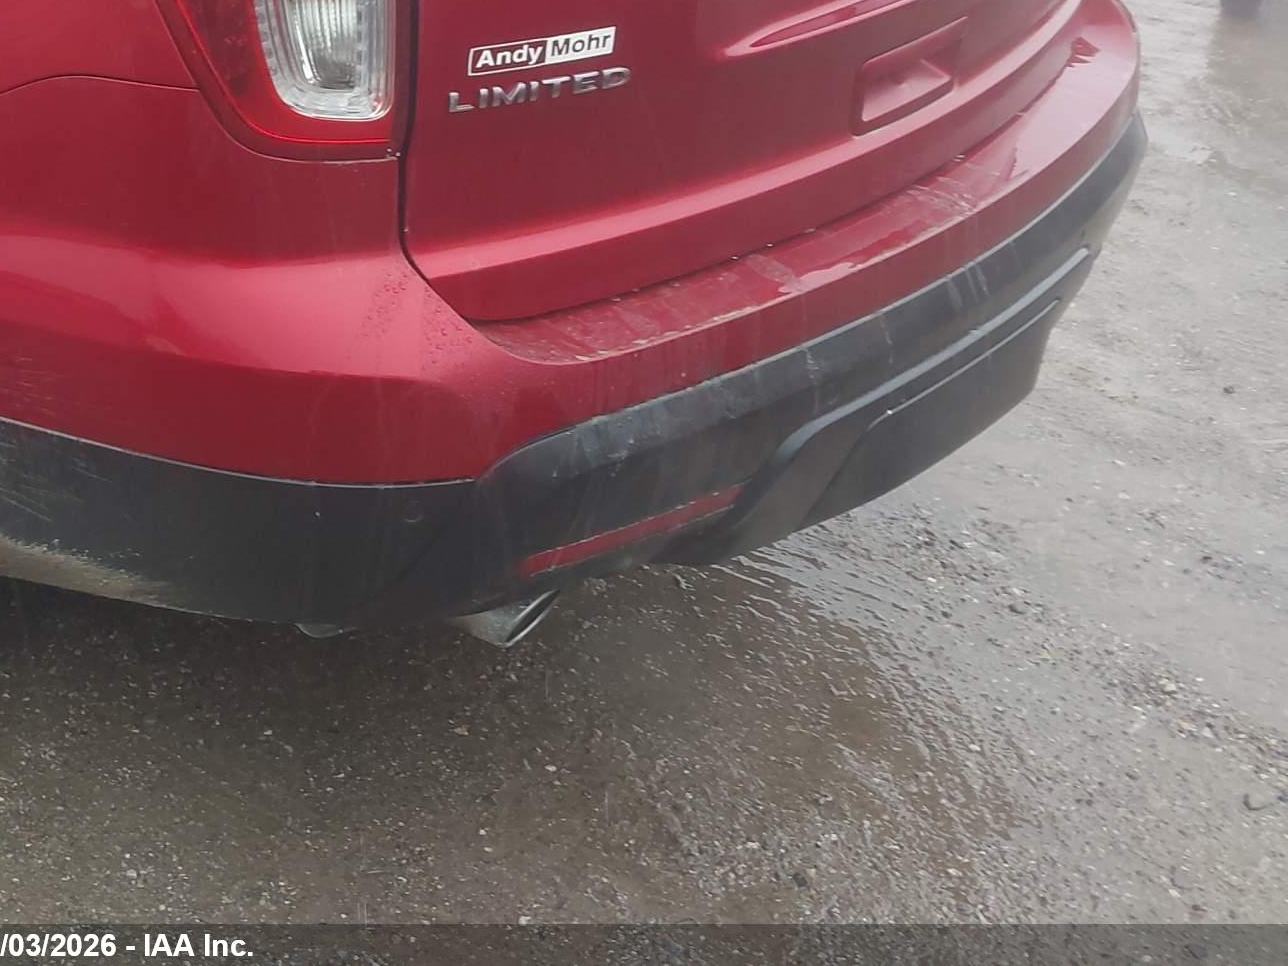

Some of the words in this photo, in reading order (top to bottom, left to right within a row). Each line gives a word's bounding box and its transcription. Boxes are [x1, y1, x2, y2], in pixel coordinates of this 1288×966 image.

[475, 44, 544, 69] Andy
[550, 33, 612, 57] Mohr
[448, 66, 632, 113] LIMITED
